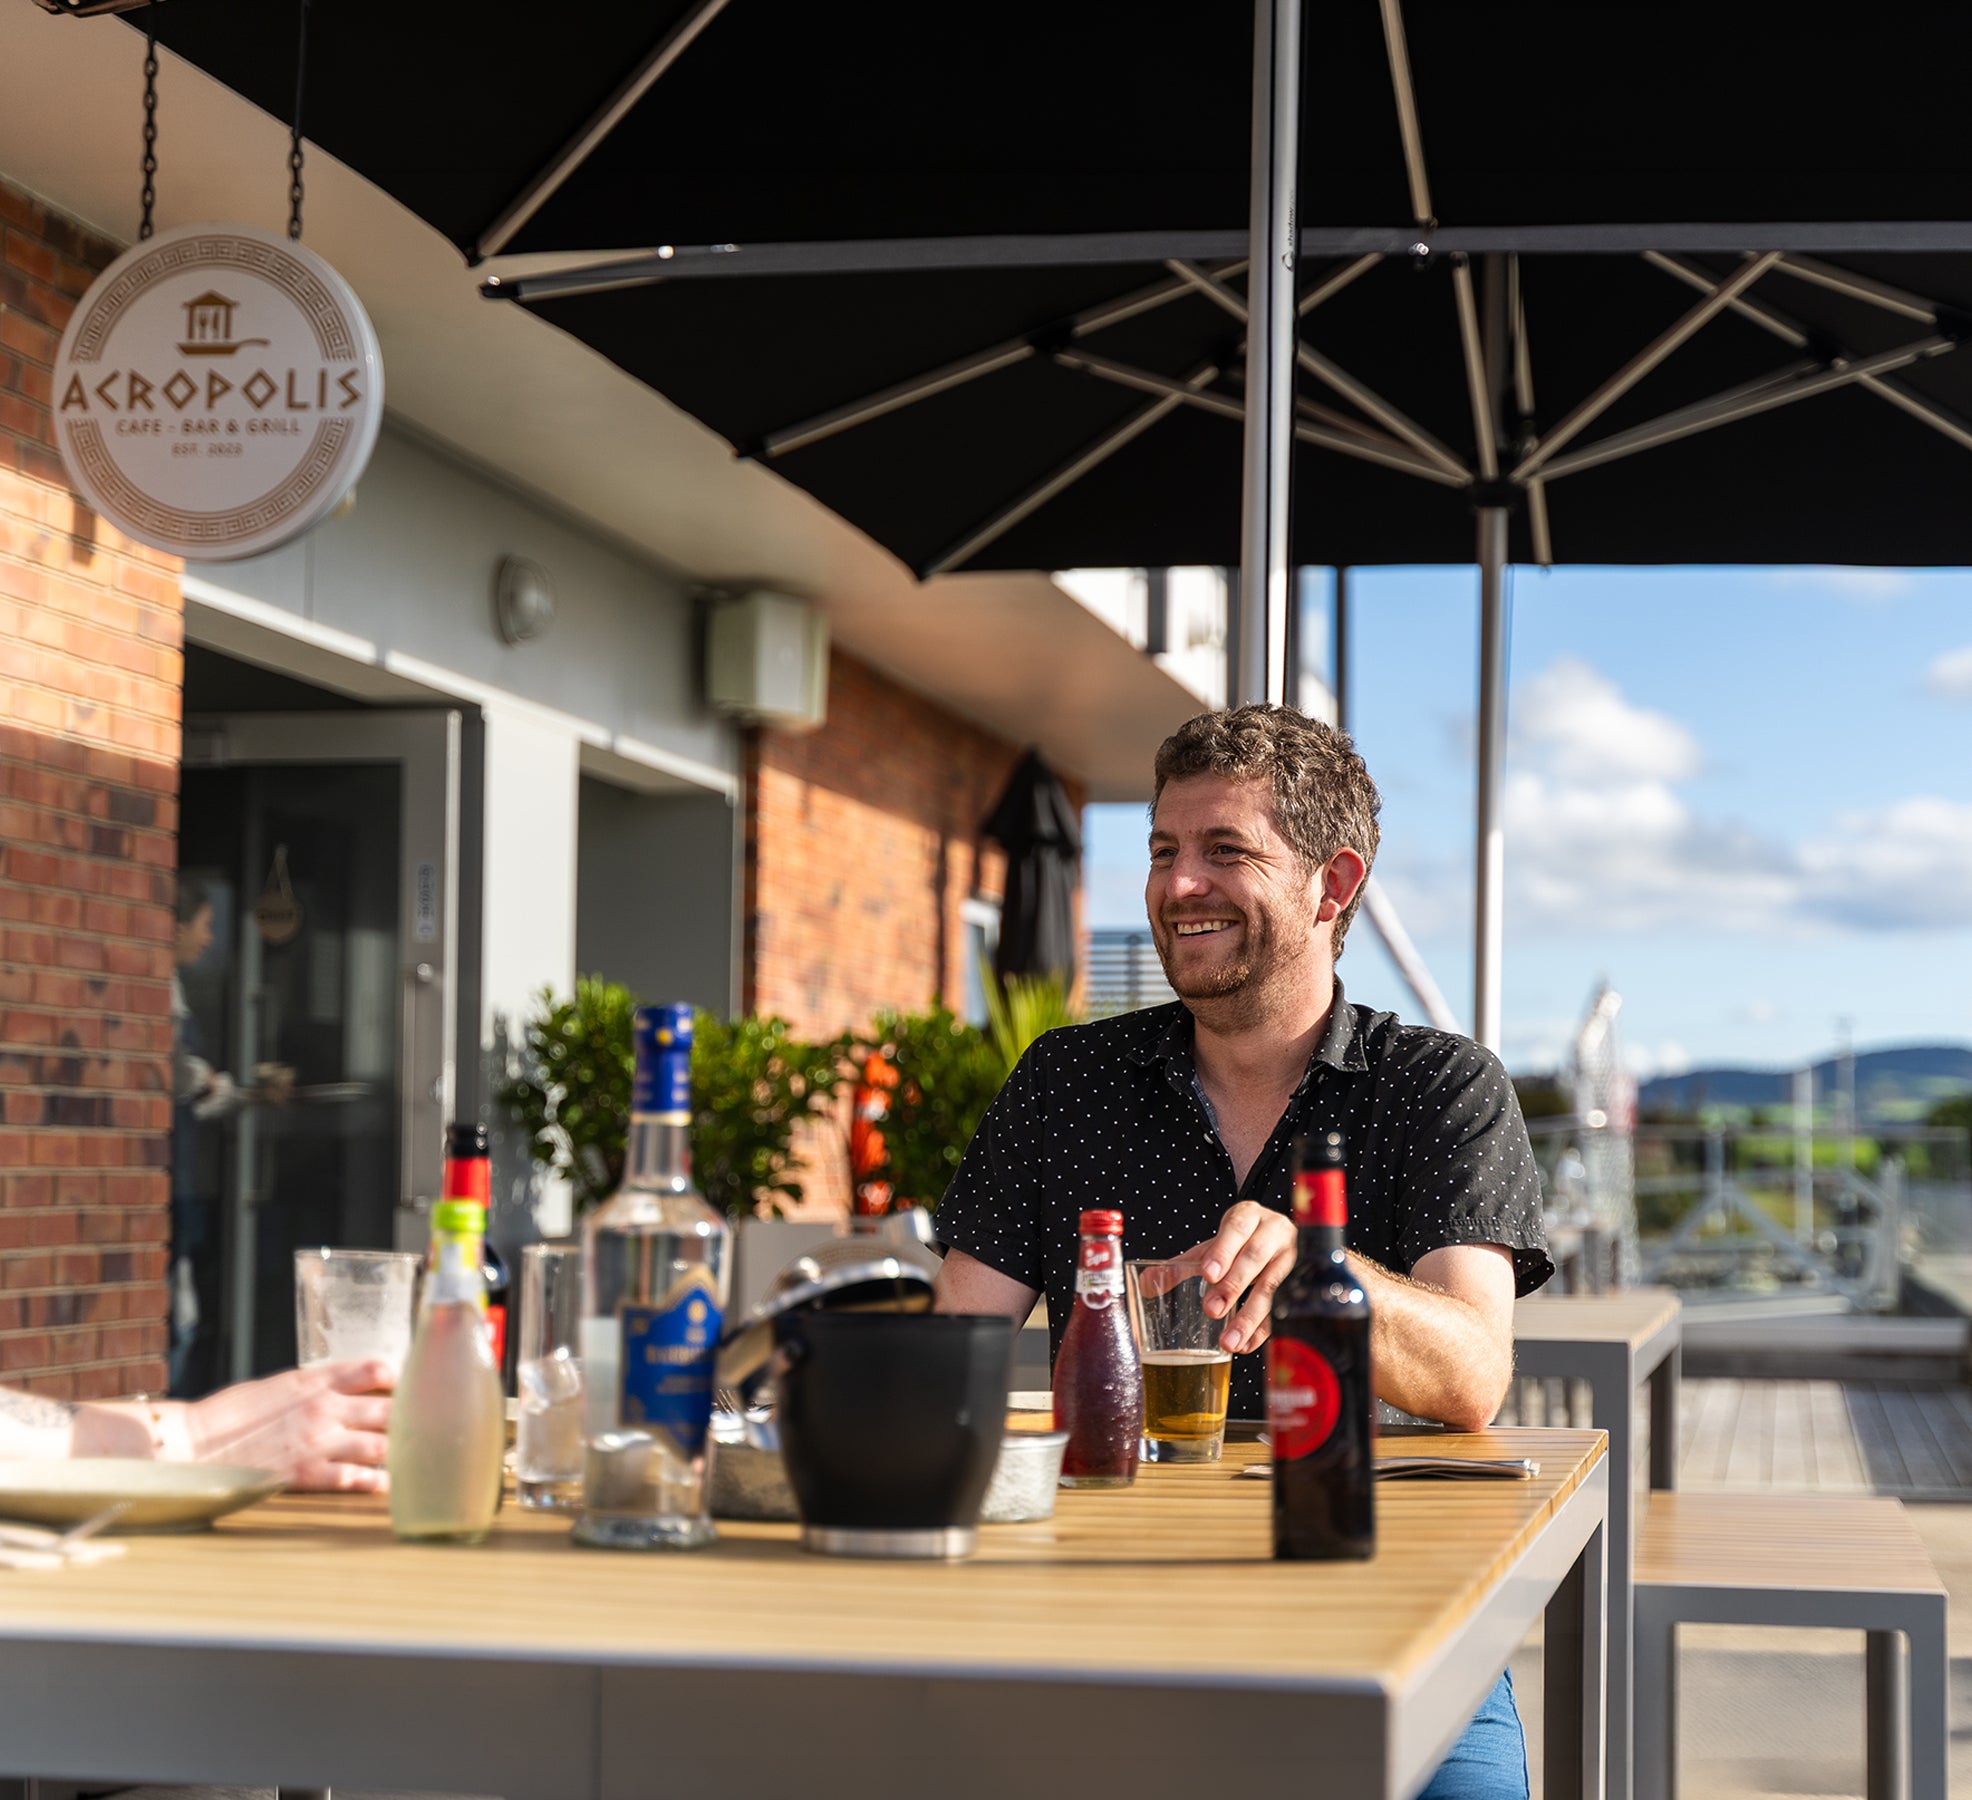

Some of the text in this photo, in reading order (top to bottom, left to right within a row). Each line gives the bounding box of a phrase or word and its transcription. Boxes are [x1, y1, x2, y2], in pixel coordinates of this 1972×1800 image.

[60, 368, 362, 411] ACROPOLIS
[116, 419, 162, 436] CAFE
[181, 419, 219, 436] BAR
[226, 419, 240, 436] &
[246, 419, 301, 436] GRILL
